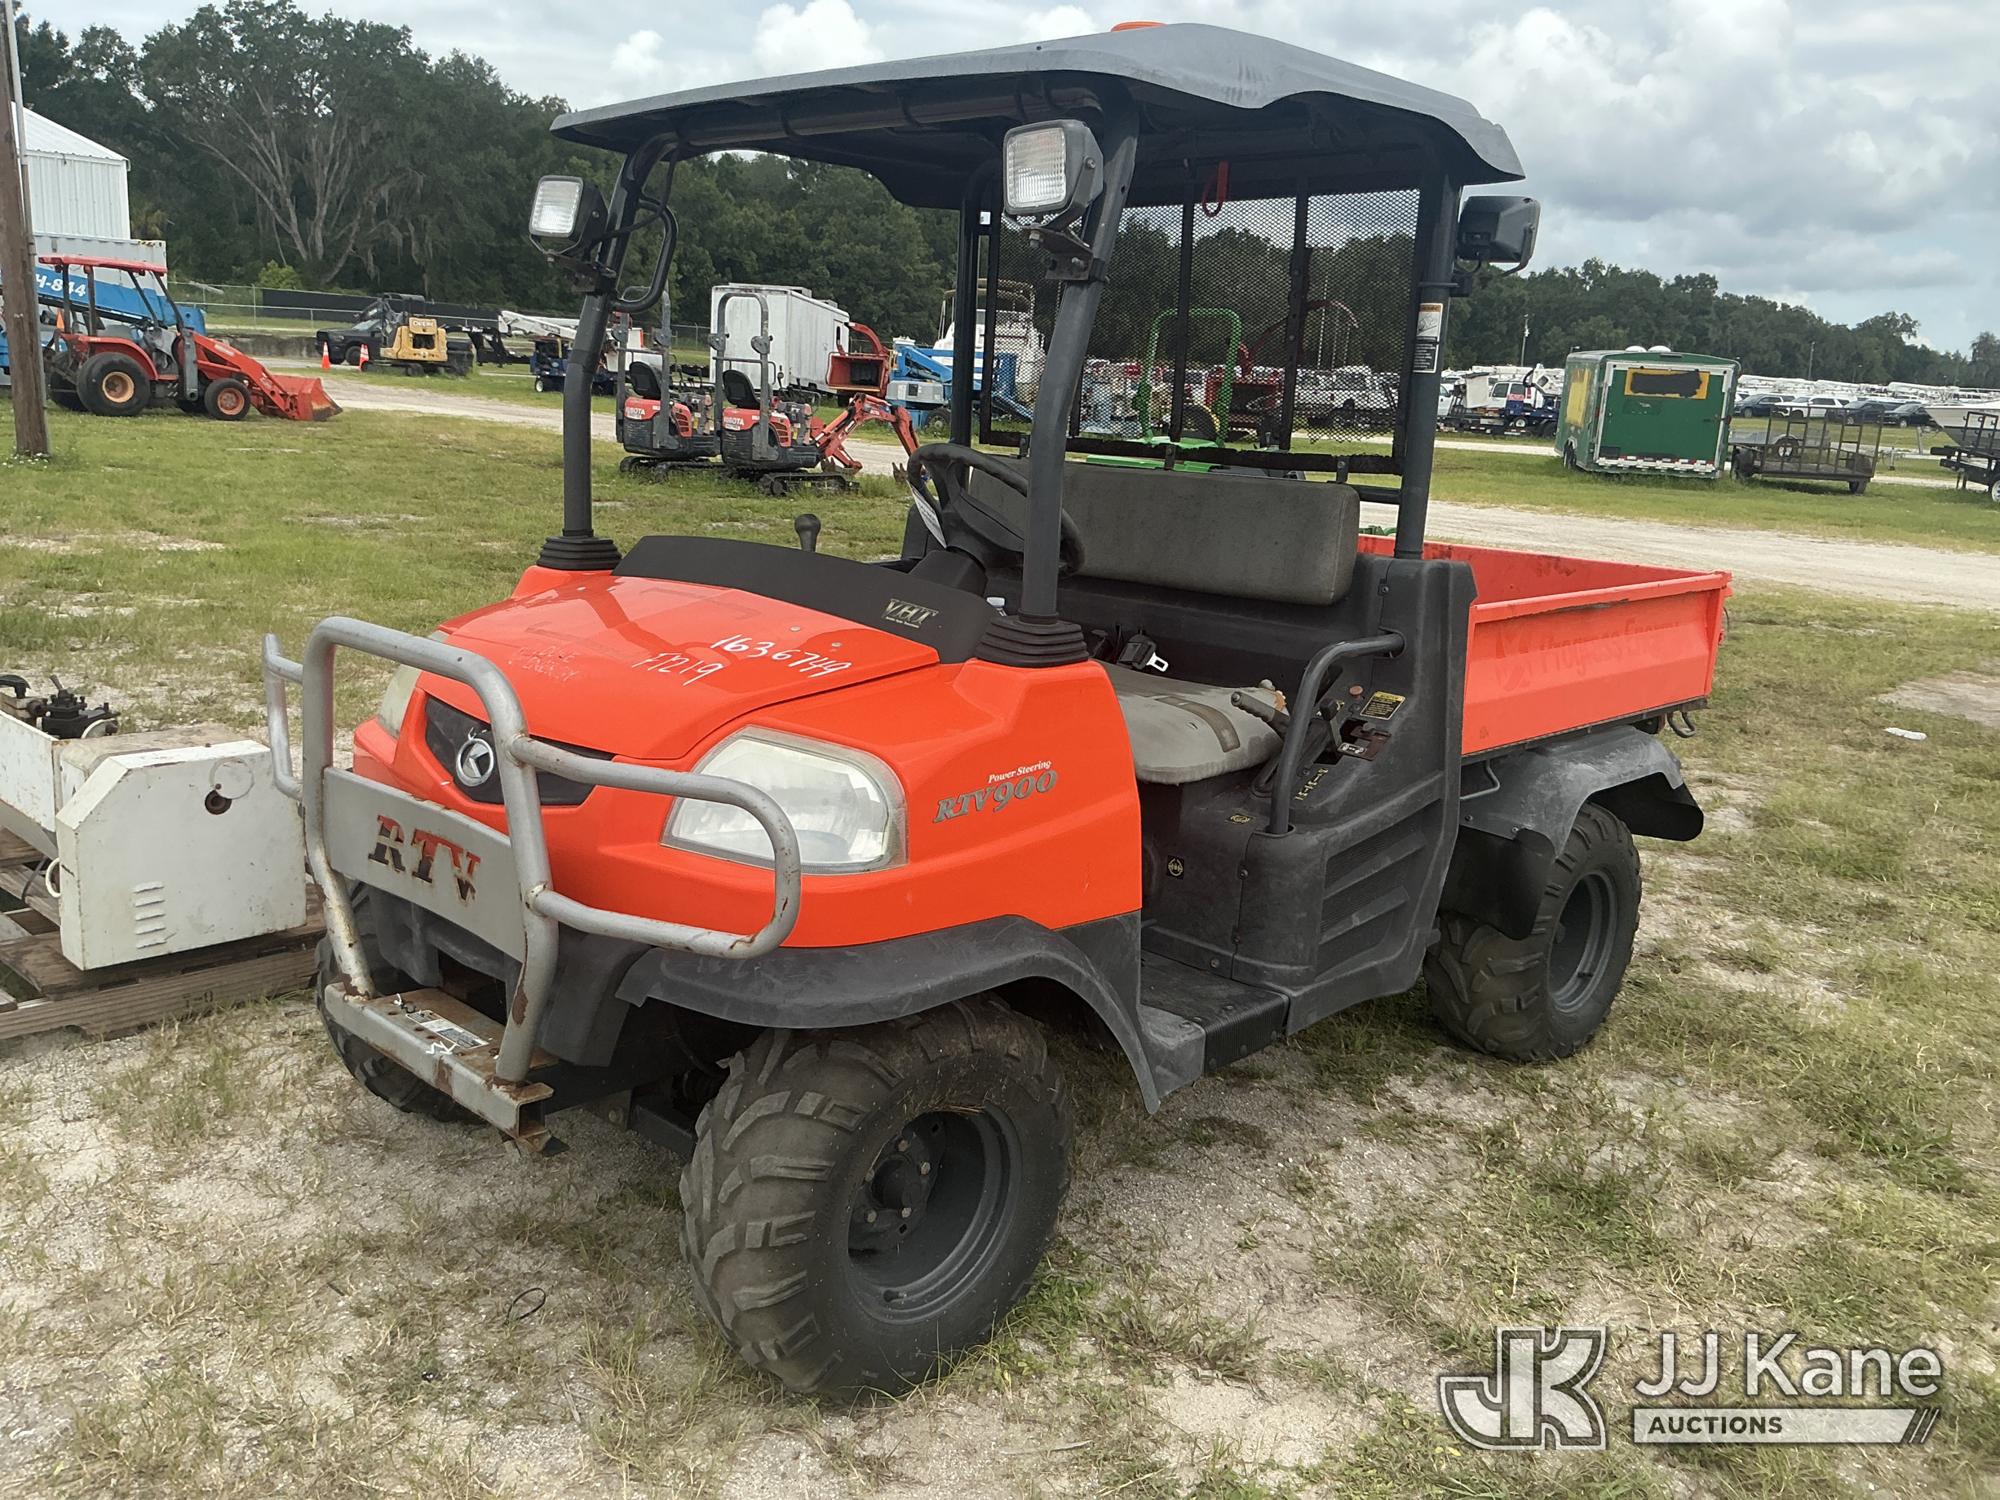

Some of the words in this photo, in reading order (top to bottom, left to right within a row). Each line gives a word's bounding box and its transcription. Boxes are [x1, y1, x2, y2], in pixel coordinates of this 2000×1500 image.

[709, 633, 852, 678] 1636749
[932, 769, 1058, 824] RTV900
[988, 770, 1017, 784] Power
[1016, 760, 1052, 776] Steering
[367, 814, 482, 904] RTV
